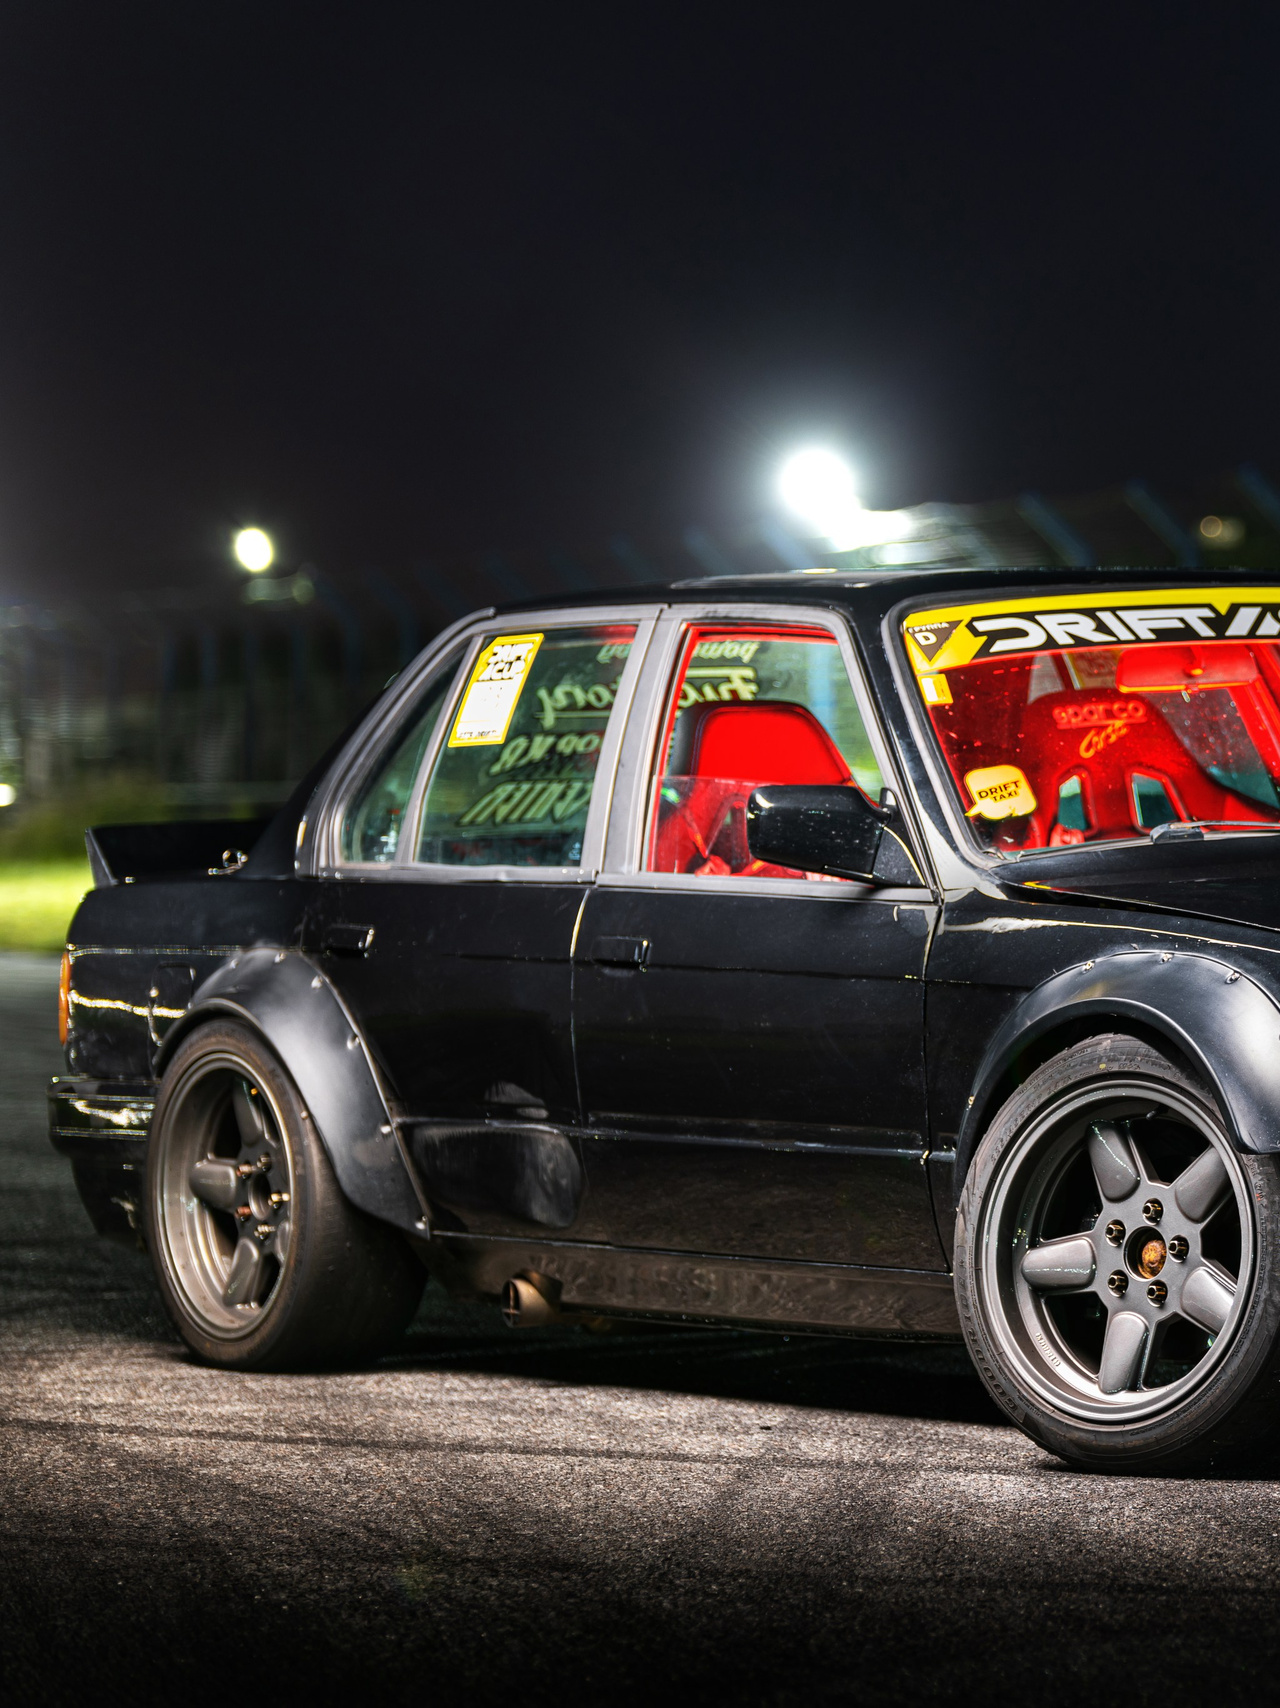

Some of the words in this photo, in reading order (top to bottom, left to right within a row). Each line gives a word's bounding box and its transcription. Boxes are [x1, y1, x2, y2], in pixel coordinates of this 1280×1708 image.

[914, 631, 938, 646] D
[973, 607, 1217, 653] DRIFT
[1053, 700, 1147, 724] sparco
[978, 780, 1020, 799] DRIFT
[993, 790, 1018, 802] TAXI
